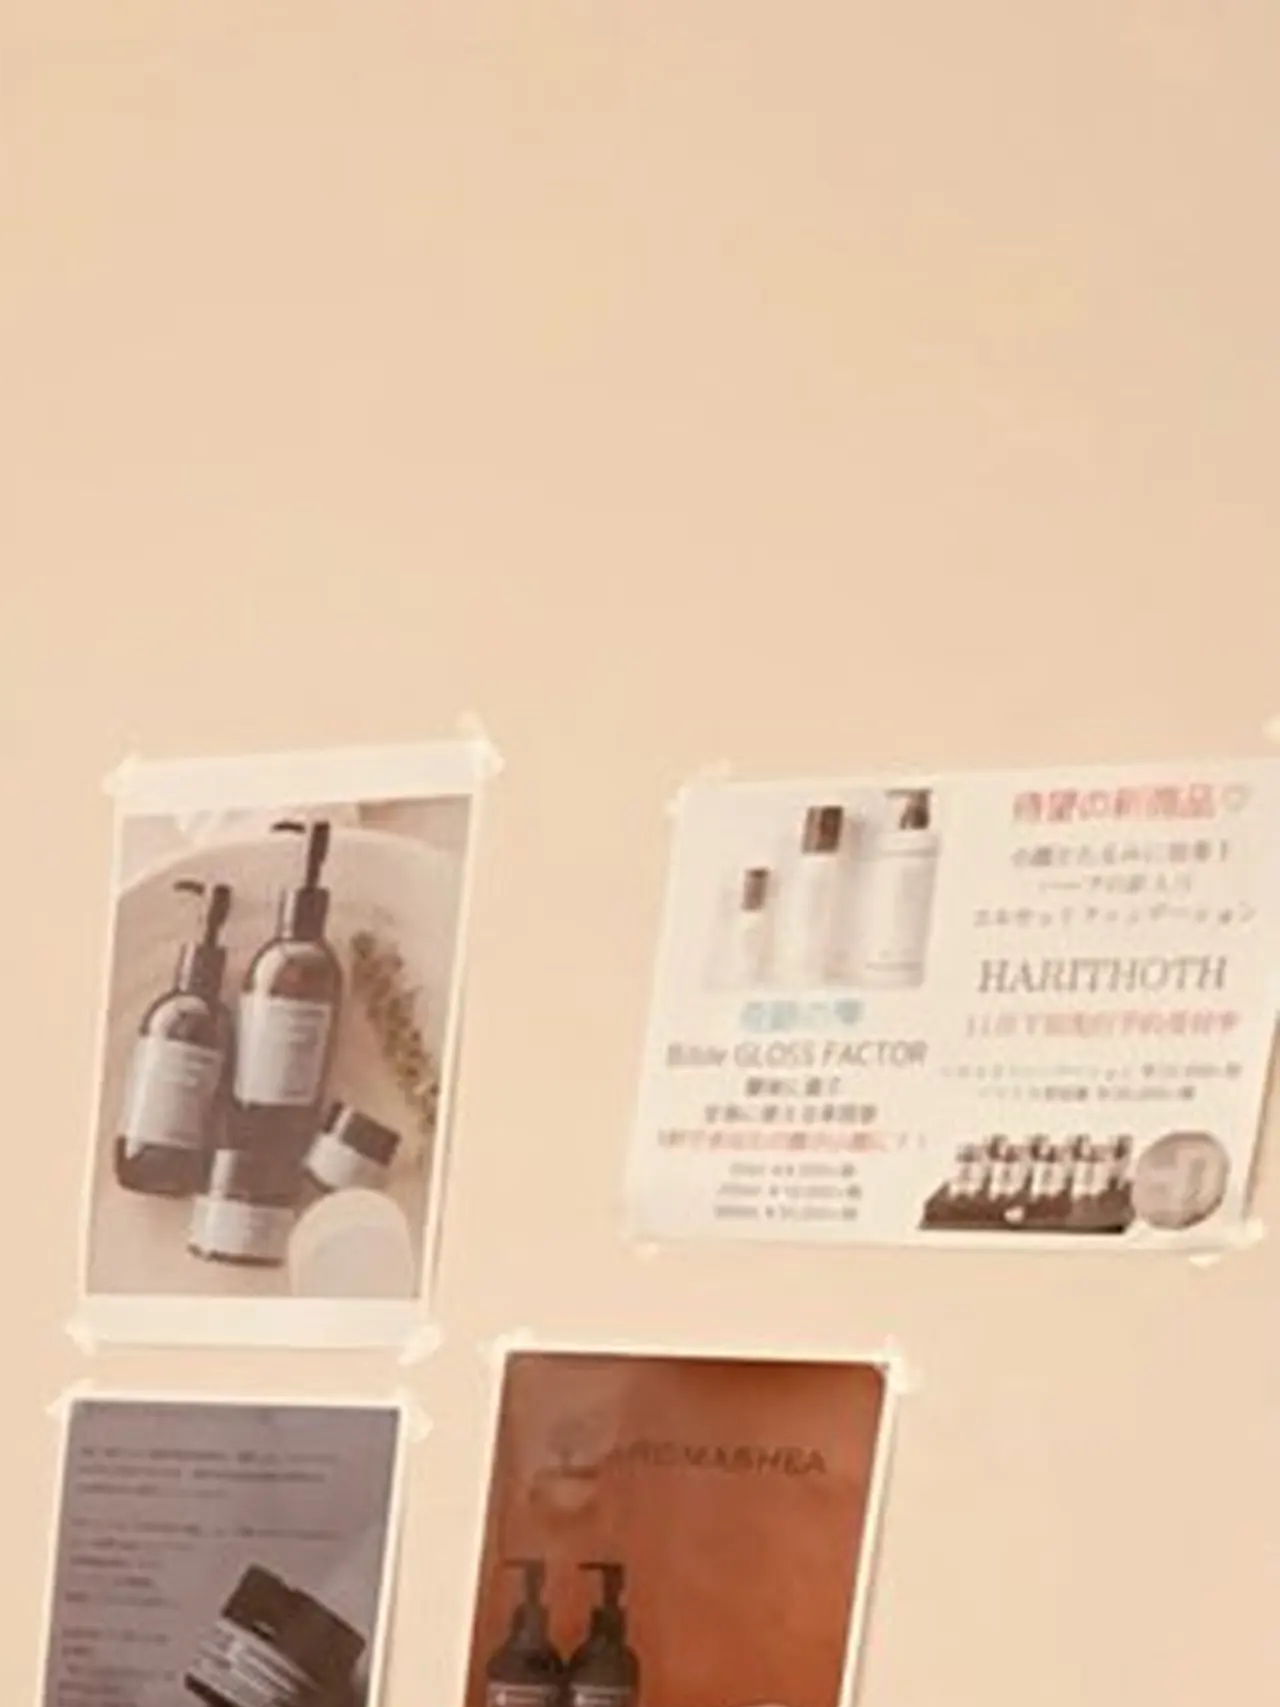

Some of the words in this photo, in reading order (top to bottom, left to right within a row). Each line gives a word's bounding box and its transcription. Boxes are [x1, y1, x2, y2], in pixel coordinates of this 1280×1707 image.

[977, 953, 1228, 993] HARITHOTH
[732, 1040, 815, 1068] GLOSS
[822, 1039, 929, 1068] FACTOR
